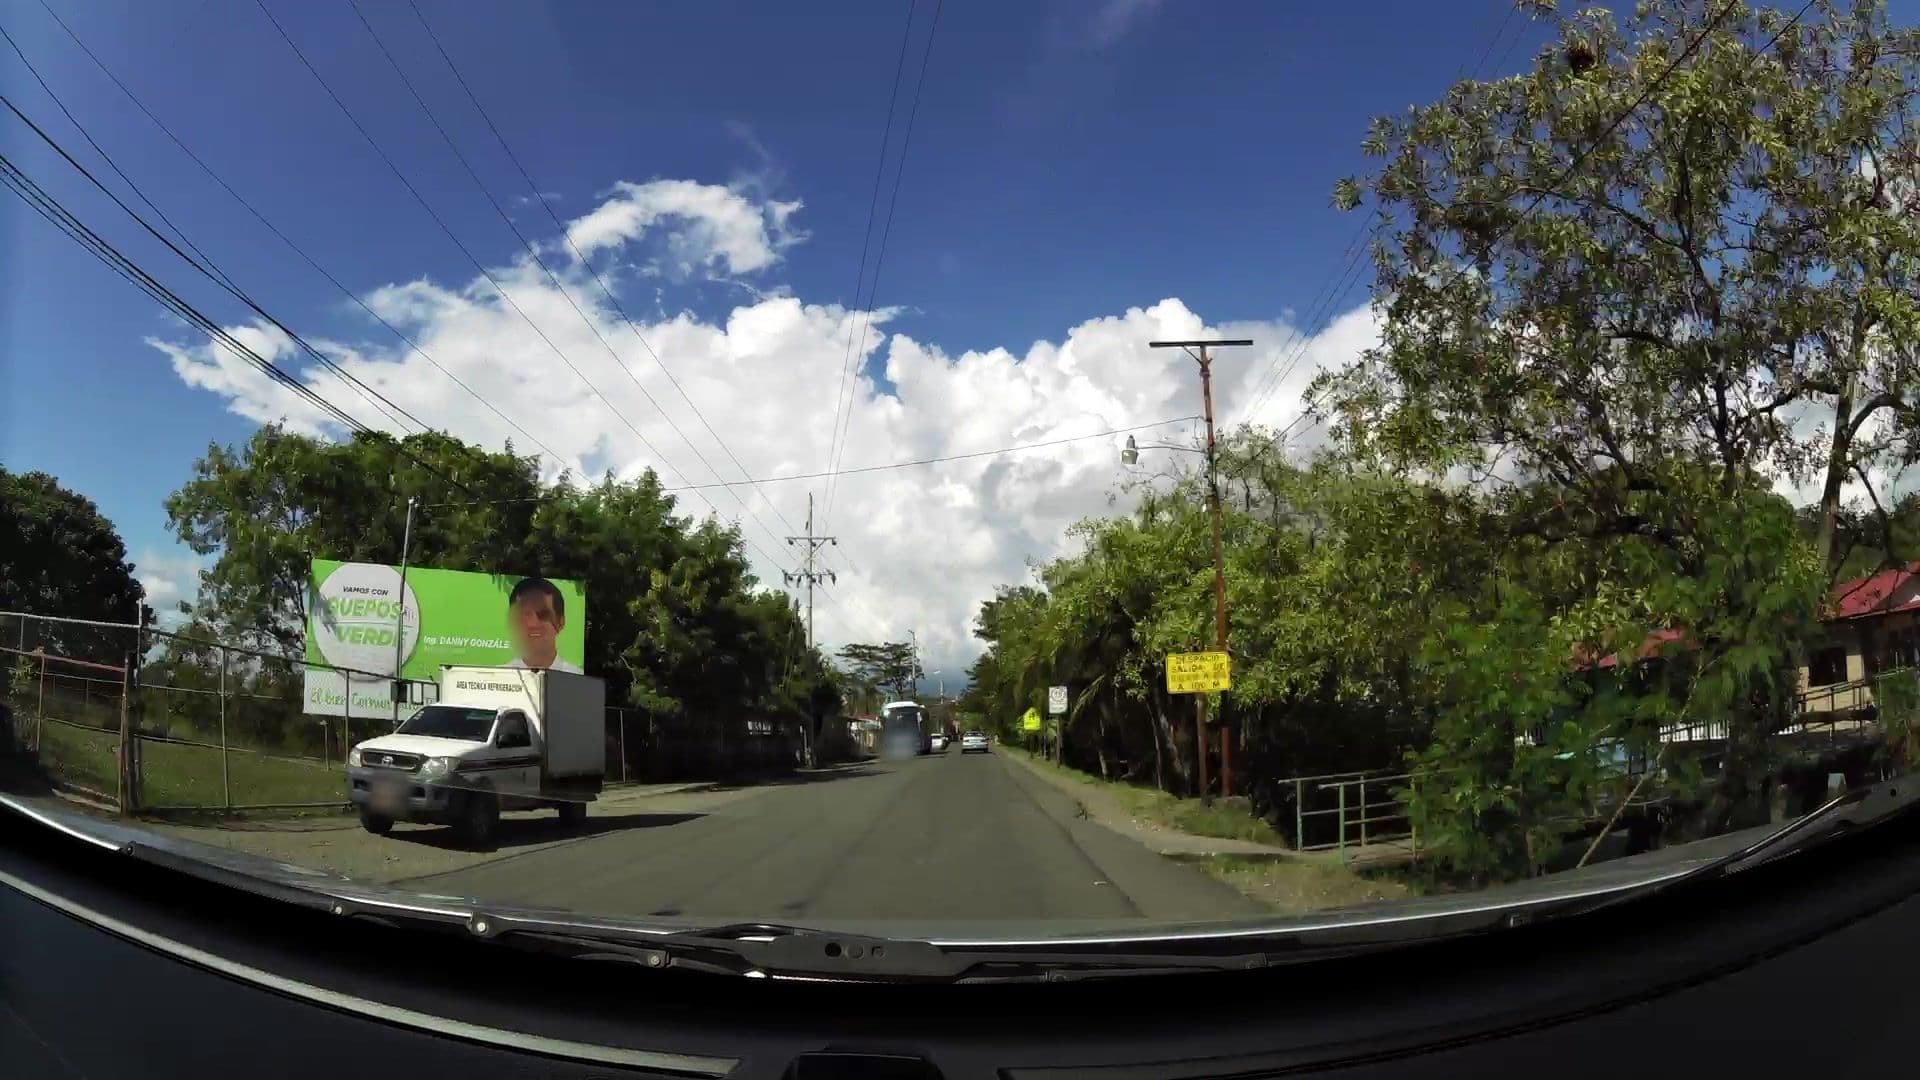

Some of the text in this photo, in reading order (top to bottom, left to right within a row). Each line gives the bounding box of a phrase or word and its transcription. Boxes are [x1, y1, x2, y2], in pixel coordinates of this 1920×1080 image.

[343, 585, 389, 596] VAMOS CON
[439, 635, 469, 647] DANNY
[470, 637, 511, 649] GONZÁLE
